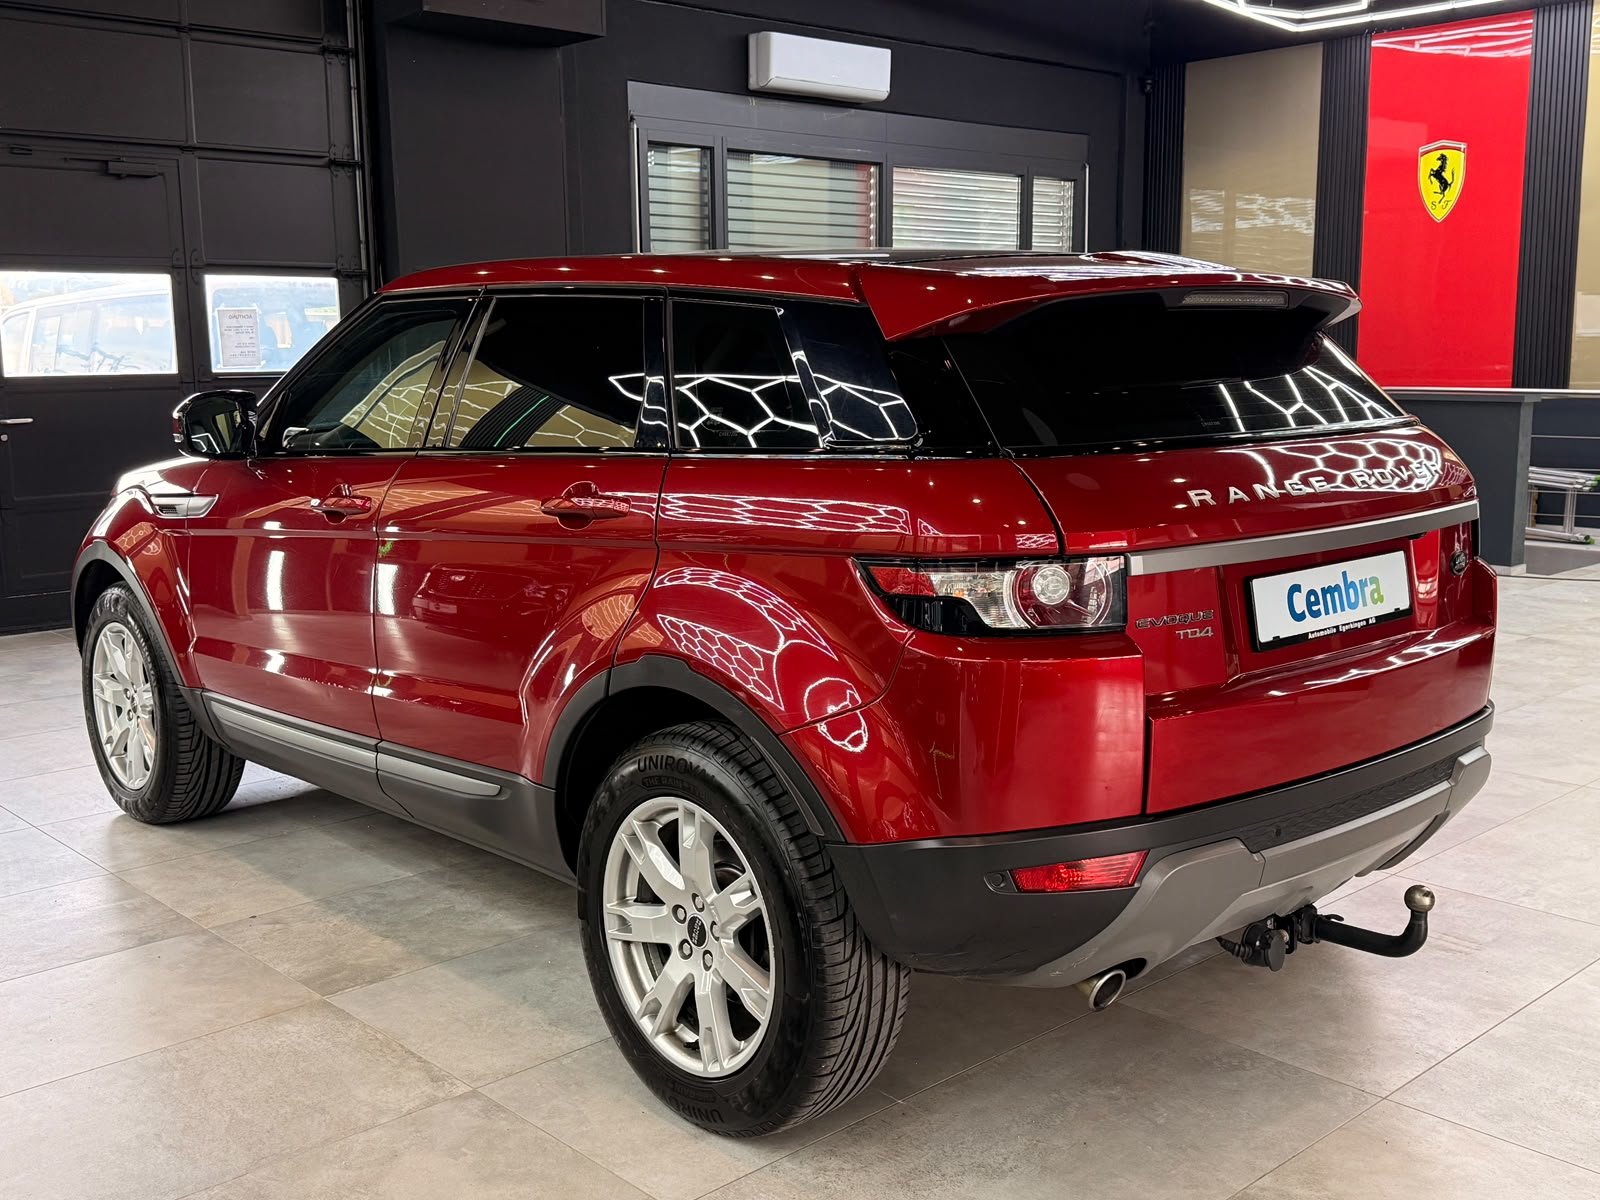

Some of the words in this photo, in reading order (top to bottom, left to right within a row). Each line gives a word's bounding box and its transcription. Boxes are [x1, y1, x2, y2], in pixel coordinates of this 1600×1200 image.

[1187, 475, 1331, 508] RANGE
[1350, 461, 1443, 488] ROVER
[1287, 570, 1384, 623] Cembra
[1136, 609, 1214, 629] EVOQUE
[1307, 627, 1337, 640] Automobile
[1368, 616, 1377, 625] AG
[1175, 626, 1214, 640] TD4
